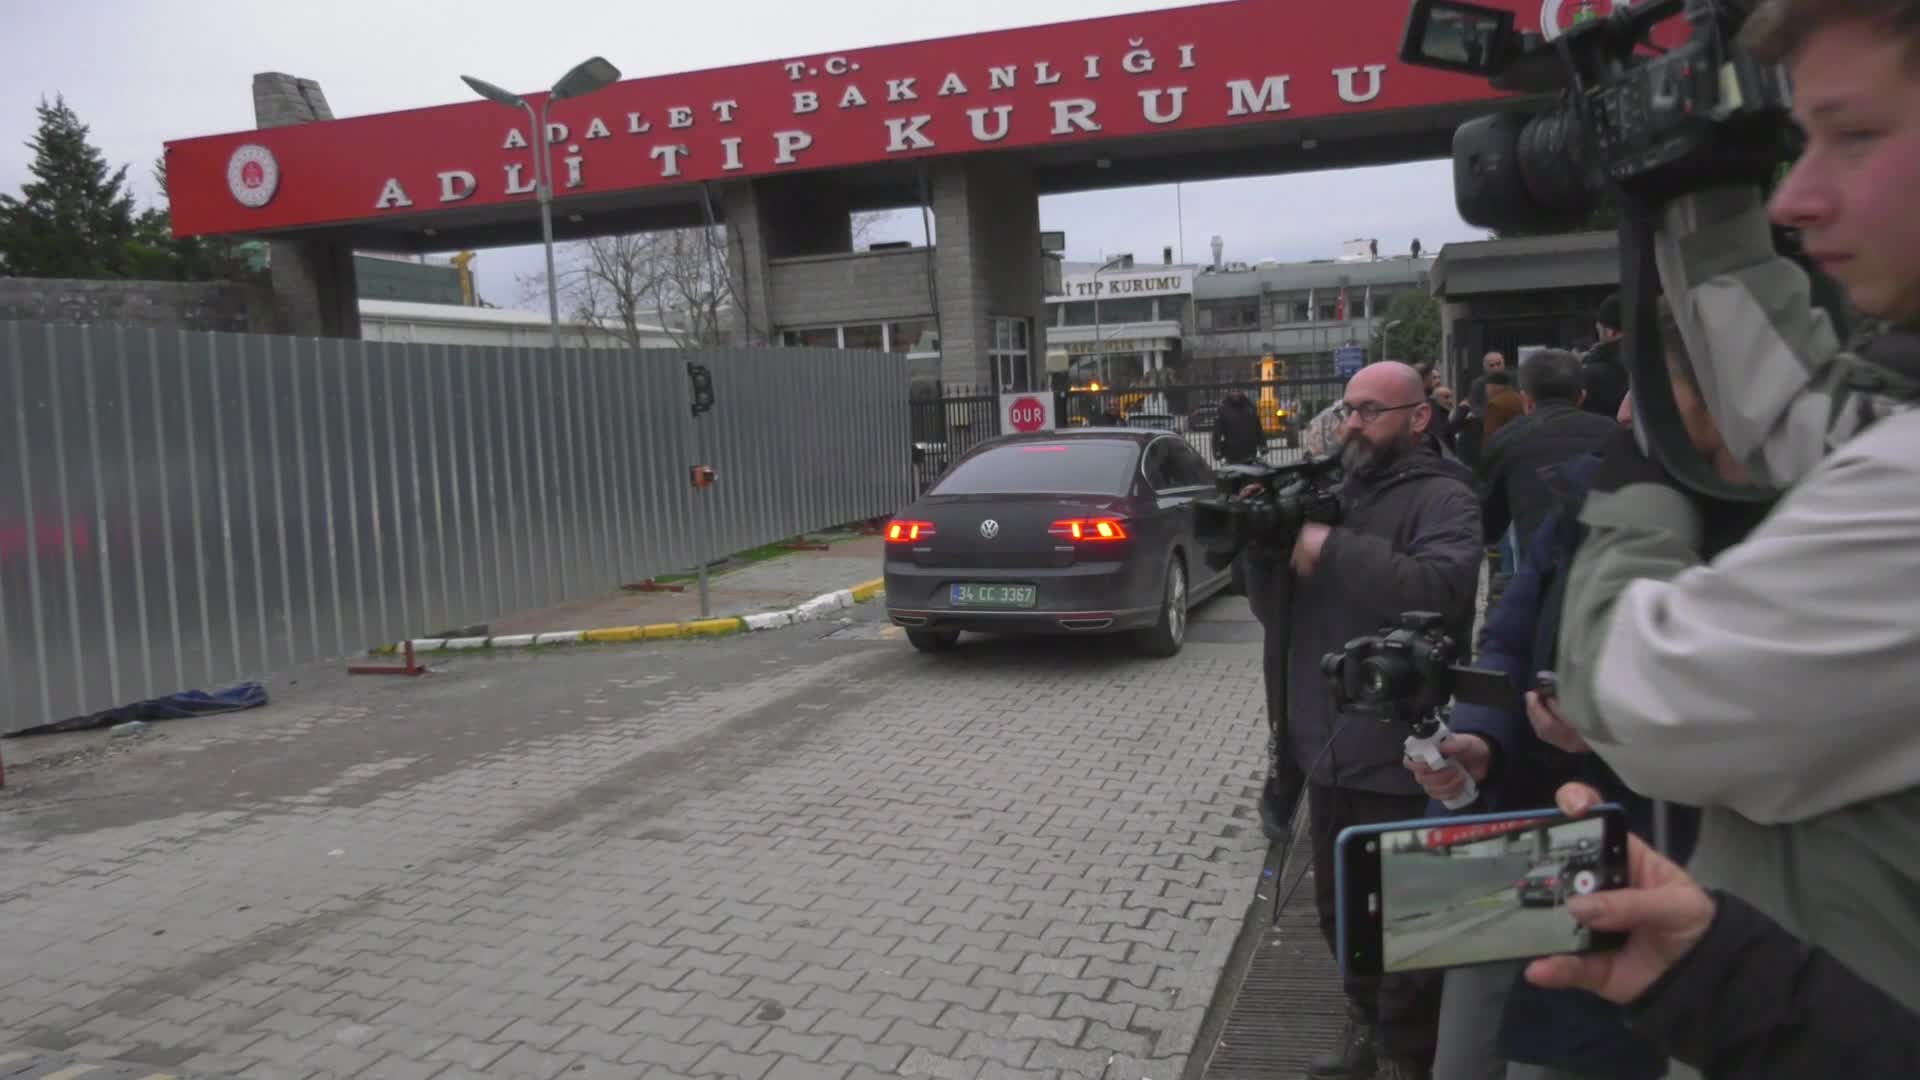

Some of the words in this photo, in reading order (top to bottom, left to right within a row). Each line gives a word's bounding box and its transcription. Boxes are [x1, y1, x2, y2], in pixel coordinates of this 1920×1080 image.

[785, 57, 860, 80] T.C.
[504, 100, 738, 149] ADALET
[793, 37, 1196, 114] BAKANLIĞI
[376, 145, 584, 208] ADLİ
[651, 131, 812, 177] TIP
[886, 64, 1387, 152] KURUMU
[1076, 282, 1103, 296] TIP
[1109, 276, 1181, 293] KURUMU
[1012, 407, 1042, 423] DUR
[959, 586, 974, 600] 34
[1001, 587, 1033, 602] 3367
